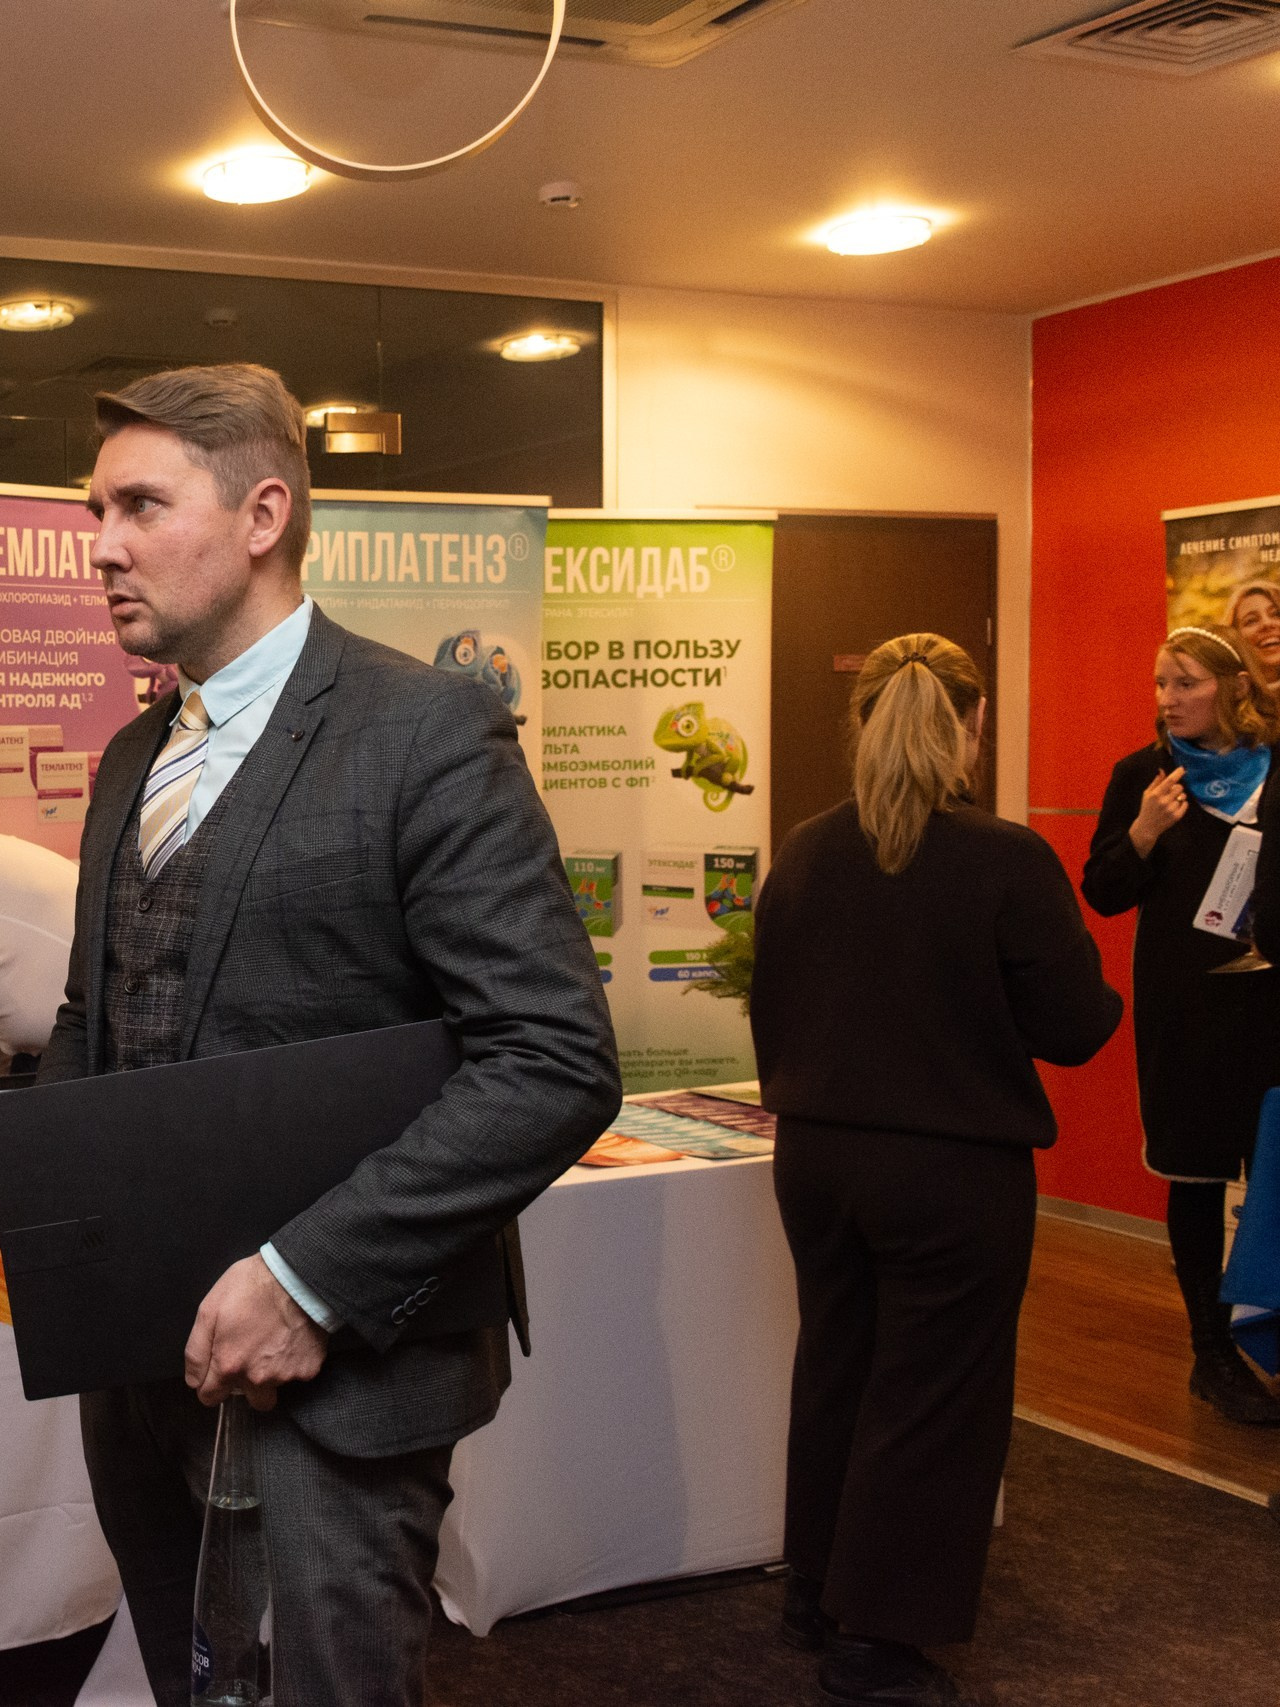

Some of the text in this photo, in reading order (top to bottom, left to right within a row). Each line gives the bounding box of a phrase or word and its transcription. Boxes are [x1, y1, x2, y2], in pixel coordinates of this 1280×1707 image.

[44, 627, 117, 647] ДВОЙНАЯ
[541, 639, 742, 661] БОР В ПОЛЬЗУ
[9, 672, 106, 689] НАДЕЖНОГО
[611, 777, 622, 788] С
[713, 858, 735, 869] 150
